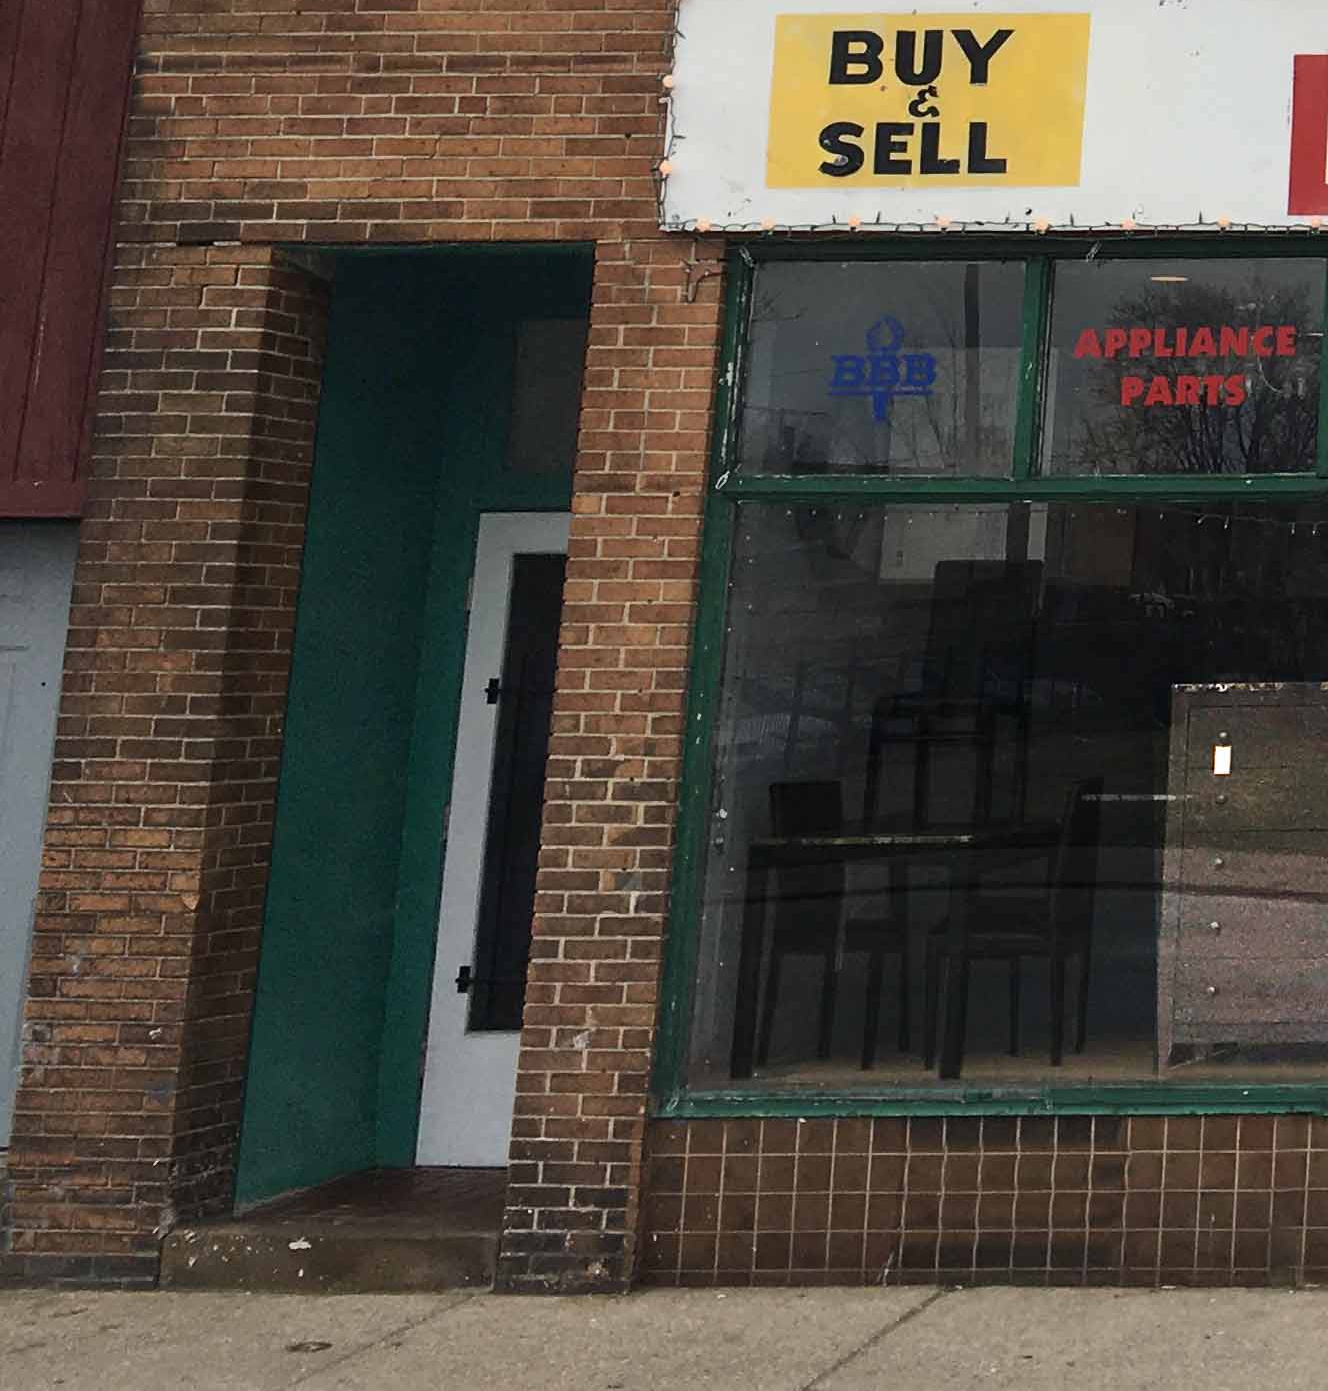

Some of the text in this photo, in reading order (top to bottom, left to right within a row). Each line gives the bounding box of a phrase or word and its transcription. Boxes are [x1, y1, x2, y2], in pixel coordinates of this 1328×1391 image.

[828, 29, 1014, 86] BUY
[908, 85, 940, 118] &
[818, 121, 1007, 177] SELL
[1074, 325, 1297, 358] APPLIANCE
[830, 352, 938, 387] BBB
[1120, 374, 1247, 407] PARTS
